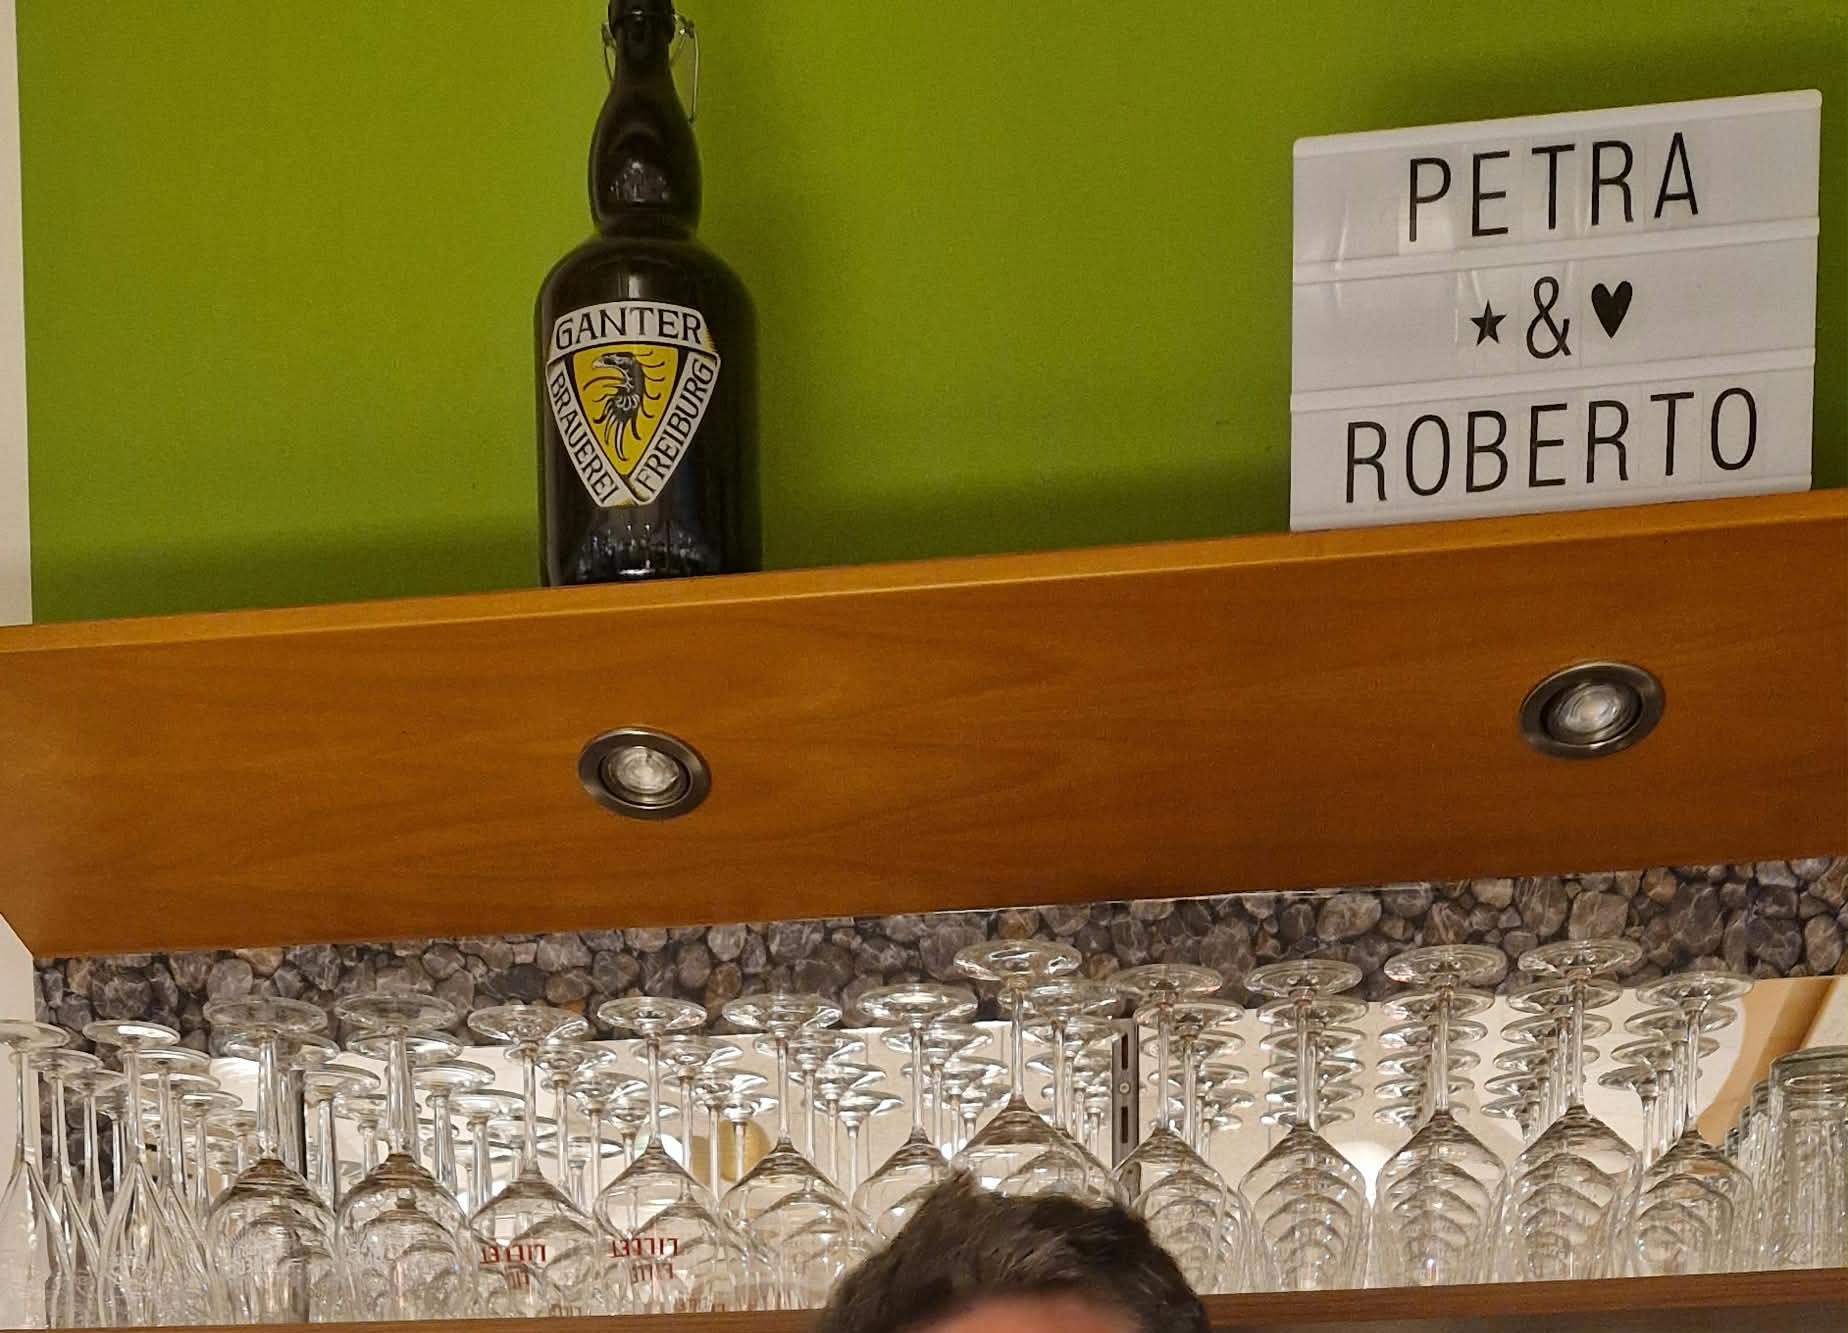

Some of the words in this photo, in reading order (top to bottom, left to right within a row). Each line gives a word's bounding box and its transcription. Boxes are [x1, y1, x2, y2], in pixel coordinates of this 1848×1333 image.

[1408, 131, 1699, 242] PETRA
[555, 306, 702, 351] GANTER
[1525, 275, 1572, 360] &
[550, 371, 620, 504] BRAUEREI
[635, 357, 715, 494] FREIBURG
[1345, 386, 1758, 504] ROBERTO
[609, 1237, 678, 1258] LILLET
